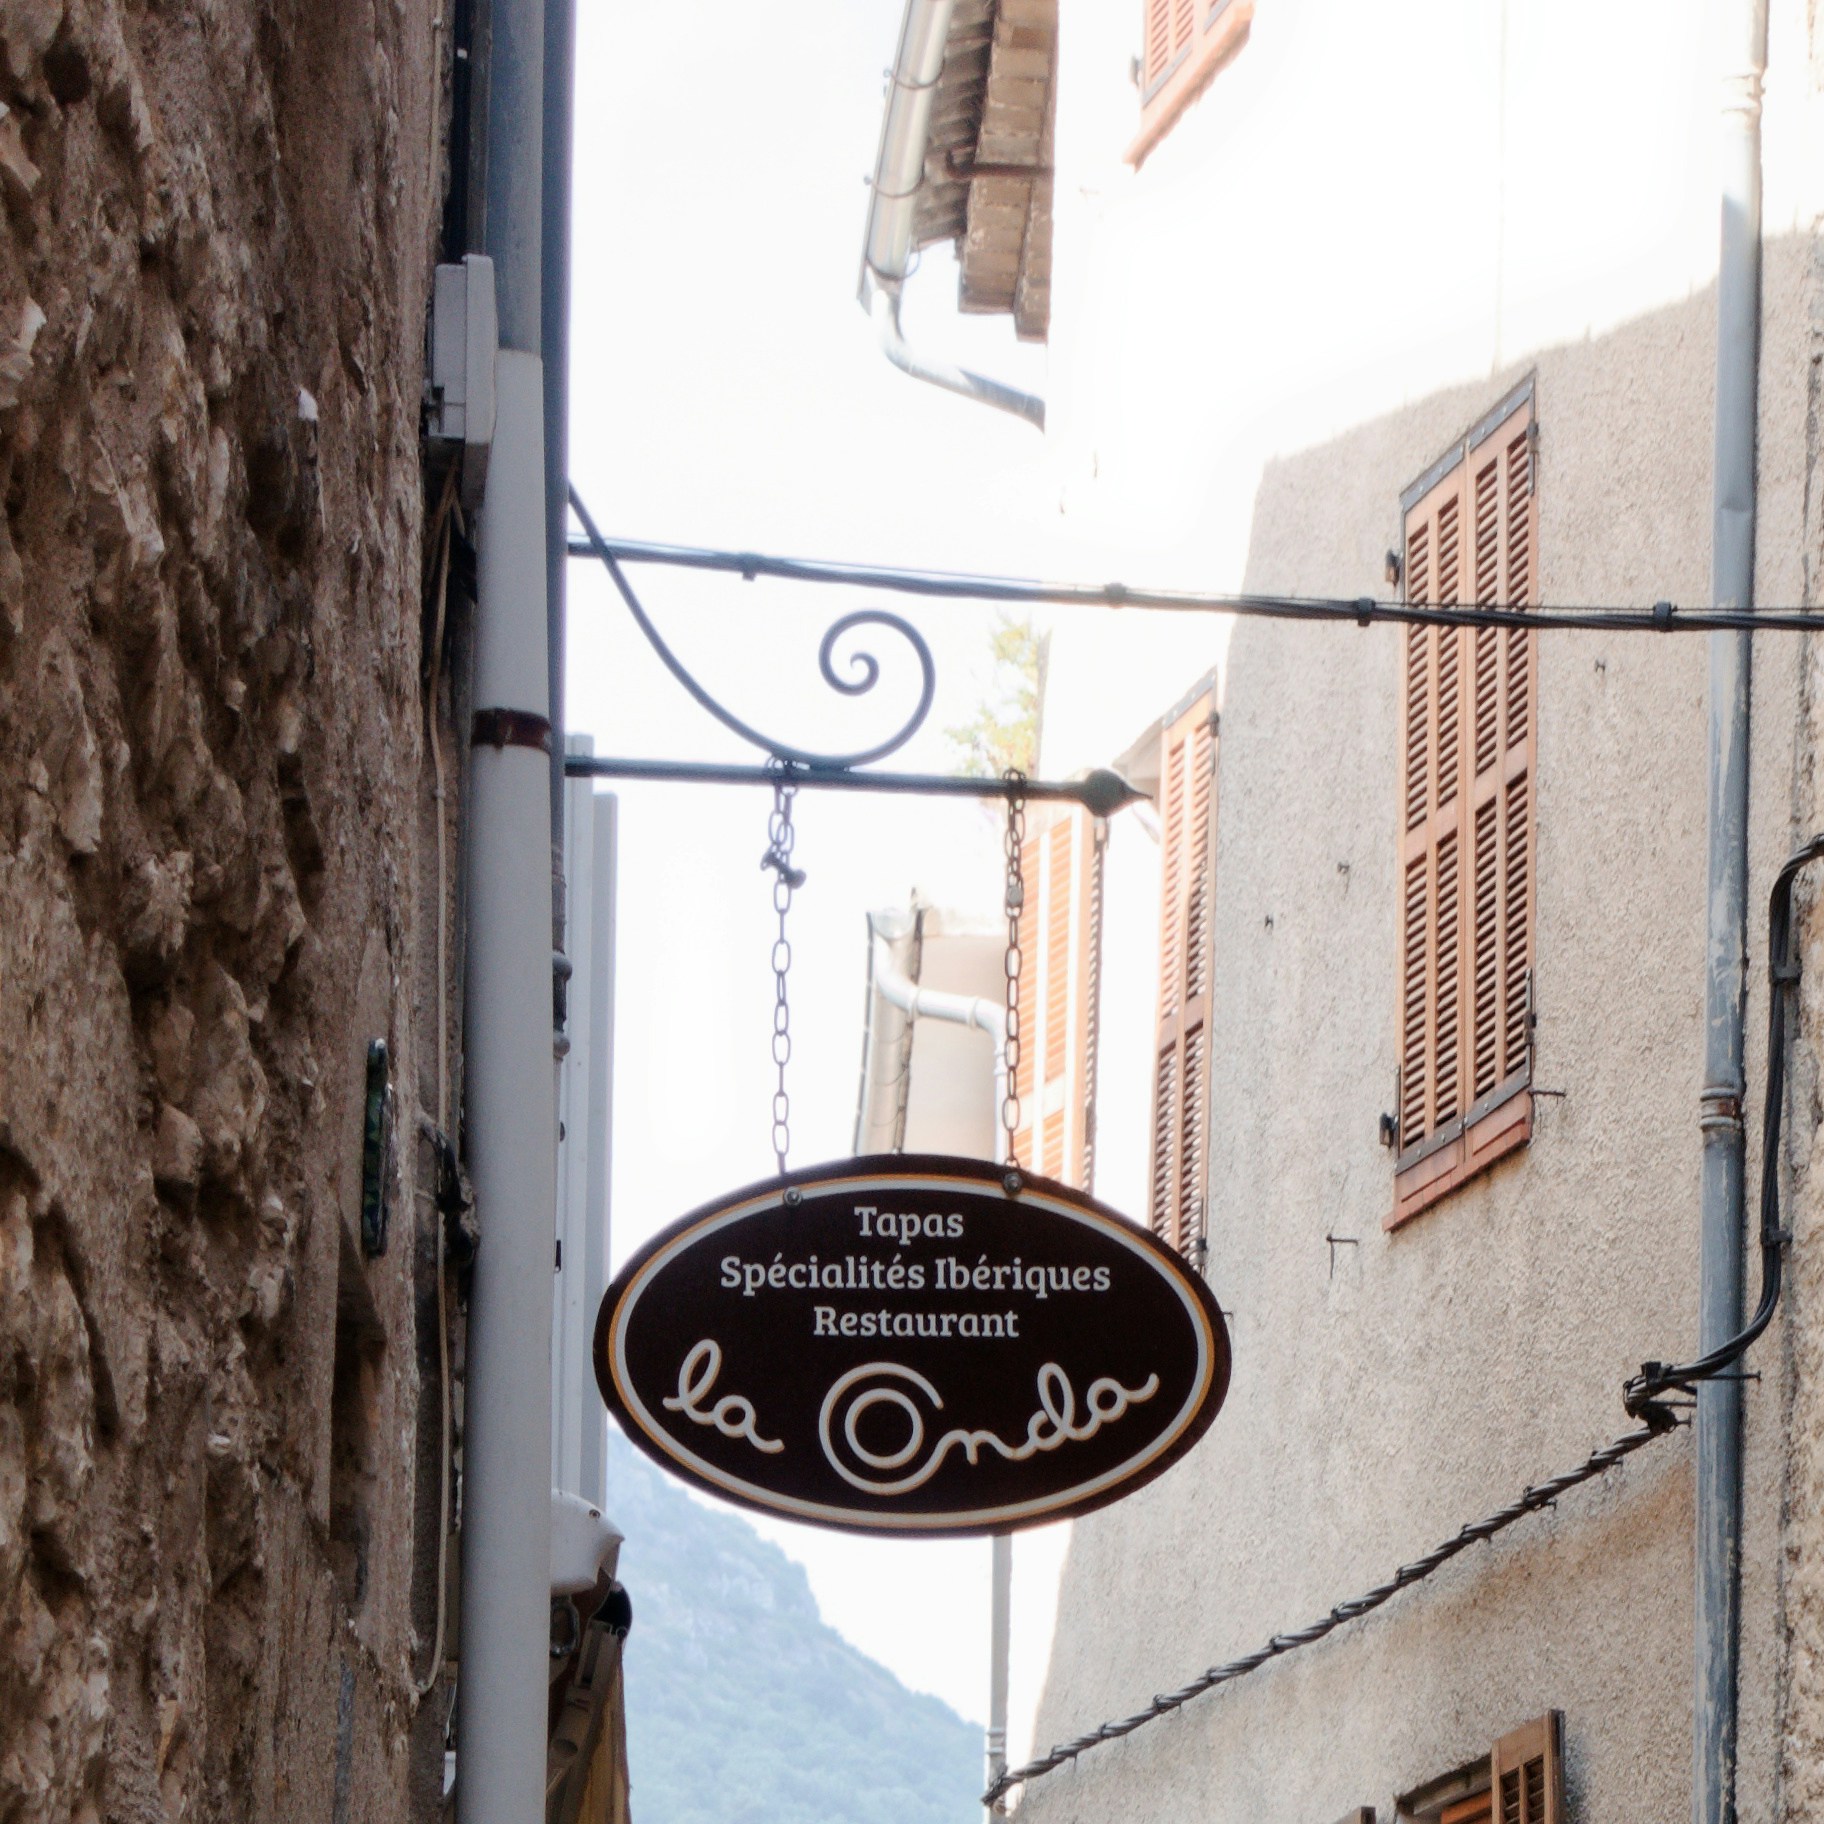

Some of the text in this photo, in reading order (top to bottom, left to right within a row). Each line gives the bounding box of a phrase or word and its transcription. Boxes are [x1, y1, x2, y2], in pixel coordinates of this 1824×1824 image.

[853, 1205, 964, 1245] Tapas
[719, 1252, 1112, 1299] Spécialités Ibériques
[812, 1305, 1020, 1339] Restaurant
[661, 1338, 1160, 1497] la Onda
